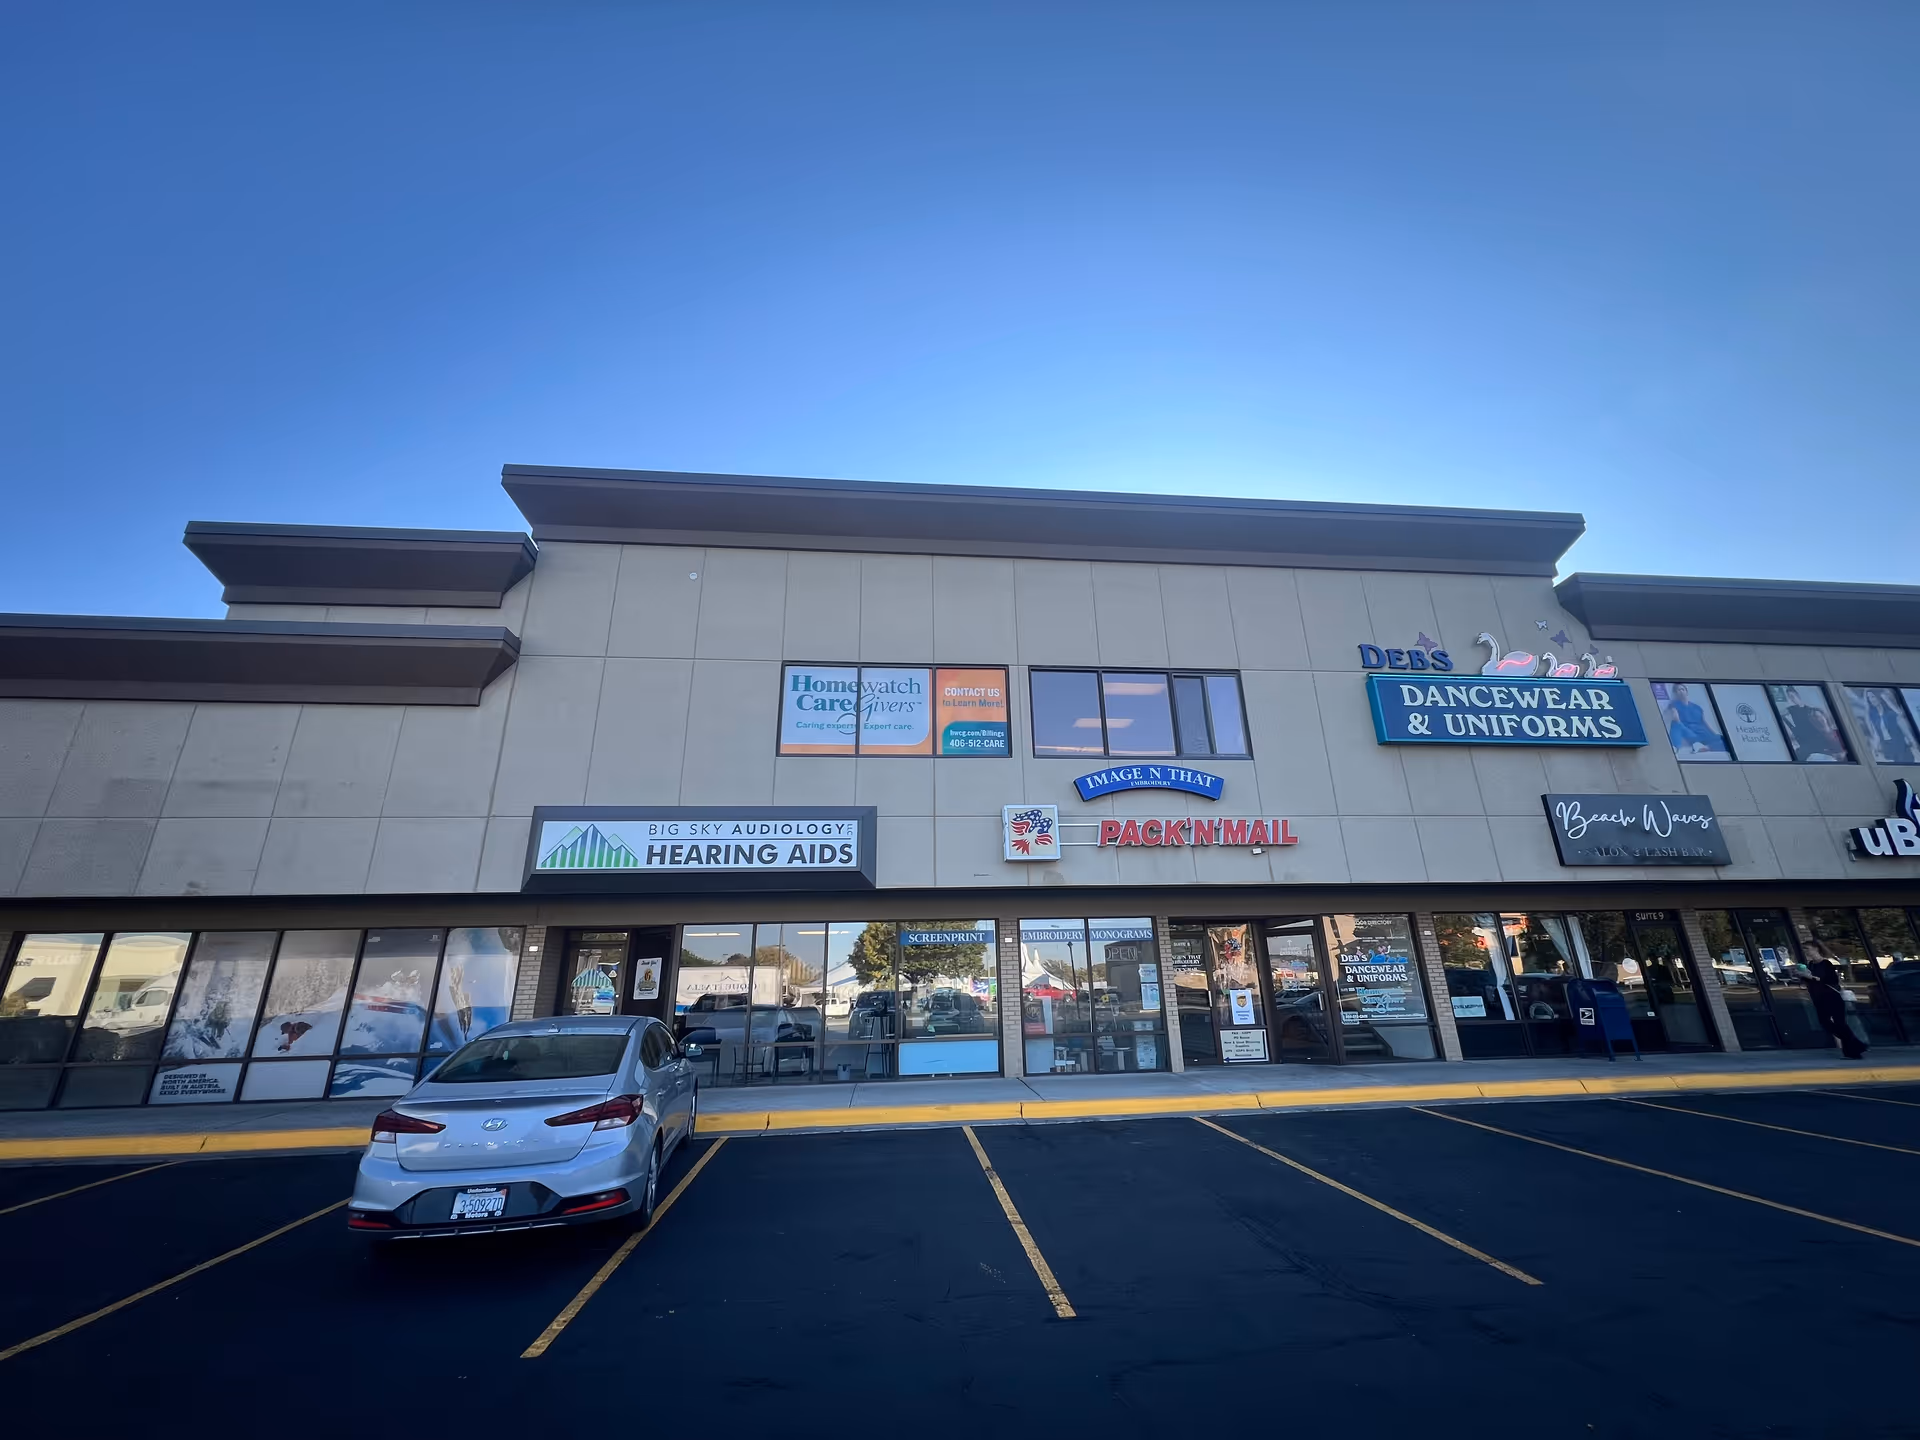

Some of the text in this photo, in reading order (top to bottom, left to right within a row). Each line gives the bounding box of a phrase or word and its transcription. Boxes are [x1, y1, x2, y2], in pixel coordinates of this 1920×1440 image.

[791, 674, 922, 694] Homewatch
[944, 687, 1000, 697] CONTACT US
[1400, 684, 1614, 710] DANCEWEAR
[952, 699, 977, 707] Learn
[796, 721, 825, 731] Caring
[1407, 712, 1623, 739] & UNIFORMS
[949, 739, 1005, 748] 406-512-CARE
[1085, 767, 1216, 789] IMAGE N THAT
[1556, 800, 1713, 839] Beach Waves
[648, 823, 680, 836] BIG
[689, 823, 723, 836] SKY
[731, 823, 845, 836] AUDIOLOGY
[1098, 817, 1299, 847] PACK'N'MAIL
[1858, 816, 1920, 855] uB
[646, 843, 854, 865] HEARING AIDS
[1635, 911, 1665, 921] SUITE 9
[908, 932, 985, 943] SCREENPRINT
[1022, 929, 1153, 940] EMBROIDERY MONOGRAMS
[1345, 965, 1406, 973] DANCEWEAR
[1346, 974, 1408, 982] & UNIFORMS
